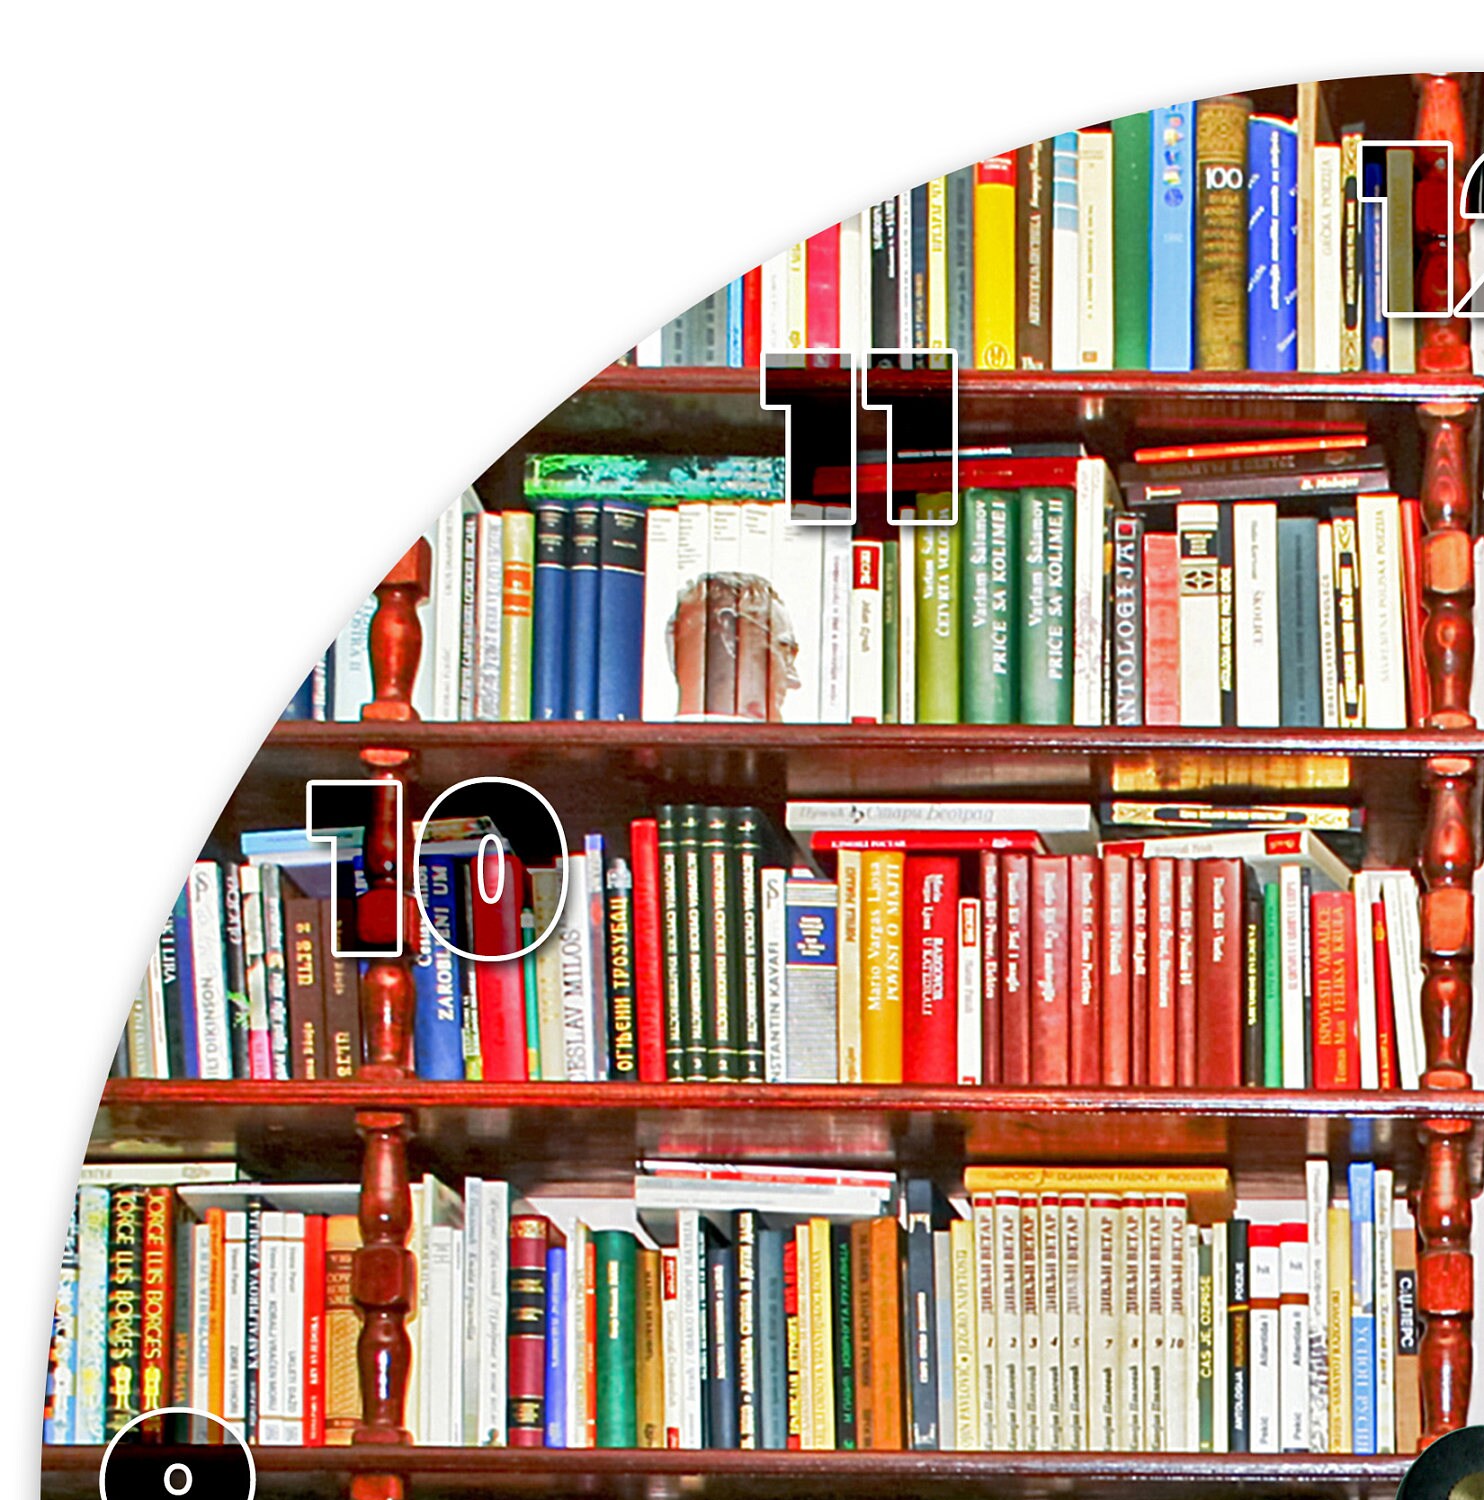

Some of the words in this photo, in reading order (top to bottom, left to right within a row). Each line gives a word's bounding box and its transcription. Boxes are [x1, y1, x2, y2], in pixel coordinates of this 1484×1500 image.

[1205, 165, 1243, 189] 100
[760, 349, 957, 524] 11
[970, 500, 987, 564] Šalamov
[991, 512, 1007, 582] KOLIME
[1026, 499, 1044, 563] Šalamov
[1047, 518, 1062, 588] KOLIME
[972, 572, 987, 627] Varlam
[991, 589, 1007, 612] SA
[1028, 572, 1044, 626] Varlam
[1047, 595, 1062, 616] SA
[990, 621, 1007, 675] PRIČE
[1046, 625, 1063, 679] PRIČE
[306, 776, 568, 961] 10
[431, 865, 449, 896] UM
[885, 864, 899, 915] MAJTI
[610, 895, 631, 990] ТРОЗУБАЦ
[867, 909, 884, 960] Vargas
[886, 923, 899, 936] O
[768, 941, 780, 997] KAVAFI
[867, 966, 882, 1011] Mario
[885, 942, 900, 1001] POVEST
[201, 977, 216, 1053] DIKINSON
[613, 996, 634, 1072] ОГЊЕНИ
[115, 1193, 136, 1244] JORGE
[145, 1194, 164, 1245] JORGE
[980, 1215, 993, 1260] ВЕТАР
[1002, 1215, 1015, 1260] ВЕТАР
[1023, 1215, 1036, 1260] ВЕТАР
[1045, 1215, 1057, 1260] ВЕТАР
[1066, 1215, 1079, 1260] ВЕТАР
[1100, 1215, 1112, 1260] ВЕТАР
[1126, 1215, 1138, 1260] ВЕТАР
[1149, 1215, 1161, 1260] ВЕТАР
[1171, 1215, 1183, 1260] ВЕТАР
[115, 1251, 134, 1284] LUIS
[144, 1251, 163, 1284] LUIS
[112, 1290, 133, 1360] BORGES
[143, 1290, 163, 1360] BORGES
